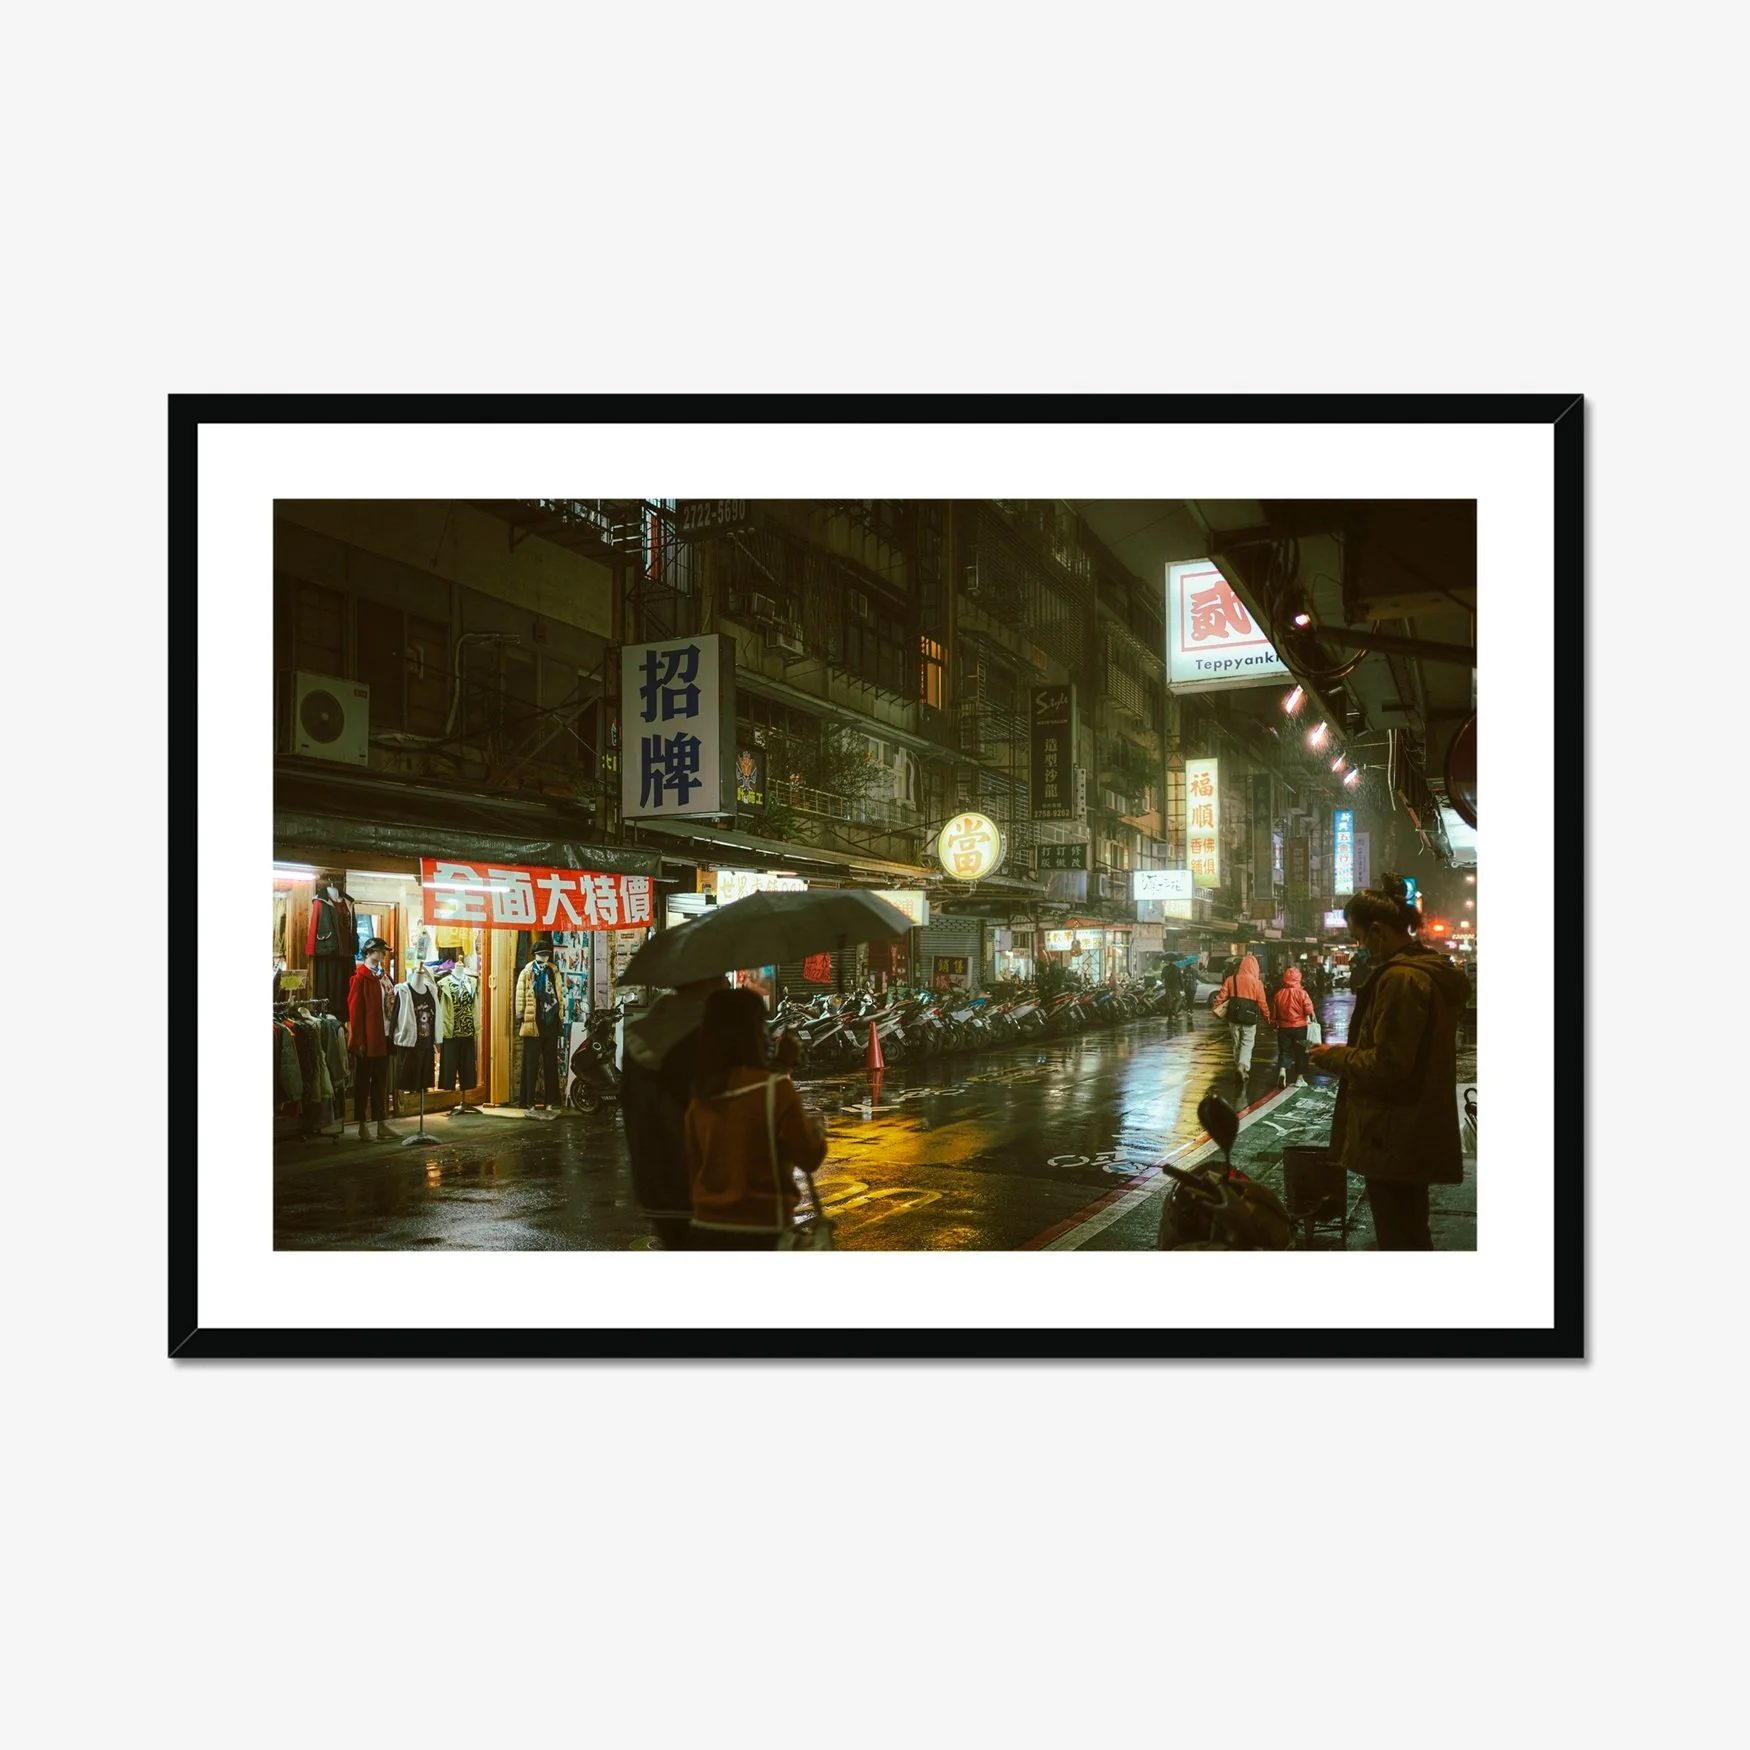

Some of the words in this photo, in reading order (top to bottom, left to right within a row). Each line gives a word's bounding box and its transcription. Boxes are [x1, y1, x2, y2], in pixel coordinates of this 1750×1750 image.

[683, 500, 746, 529] 2722-5690
[639, 644, 702, 808] 招牌
[1044, 737, 1058, 799] 造型沙龍
[1190, 773, 1214, 829] 福順
[947, 816, 991, 873] 當
[432, 862, 650, 926] 全面大特價
